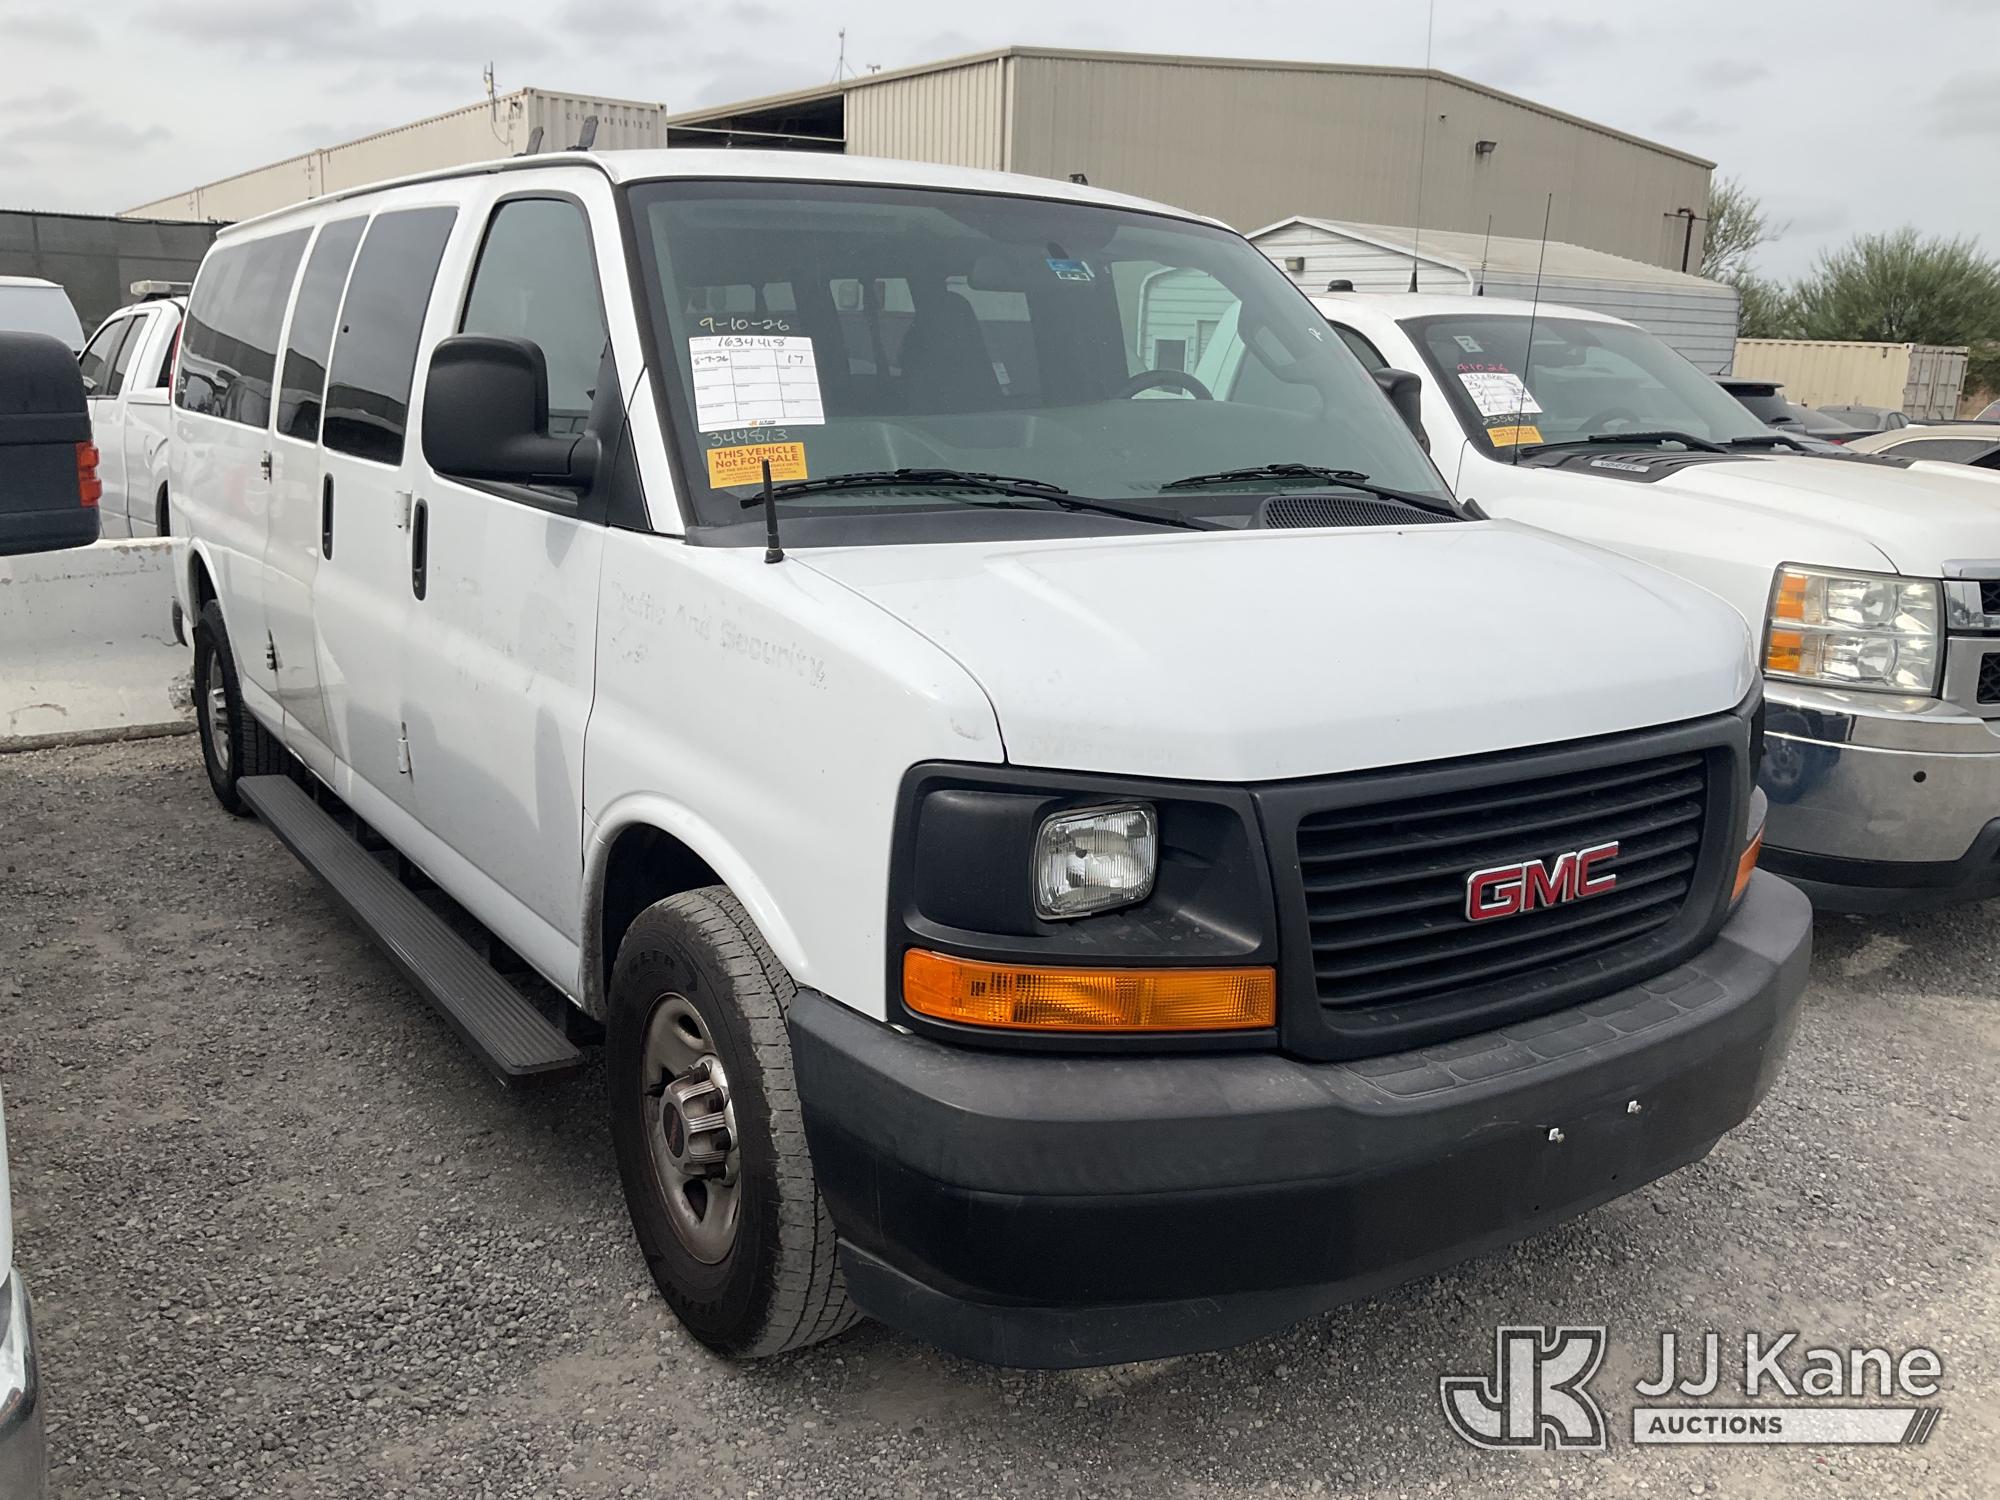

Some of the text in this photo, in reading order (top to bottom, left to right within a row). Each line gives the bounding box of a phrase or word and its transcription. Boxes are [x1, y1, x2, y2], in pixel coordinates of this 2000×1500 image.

[699, 317, 790, 333] 9-10-26
[787, 355, 804, 364] 17
[707, 428, 788, 447] 344813
[715, 445, 798, 460] THIS VEHICLE
[715, 459, 739, 469] Not
[768, 453, 799, 463] SALE
[1465, 840, 1620, 922] GMC
